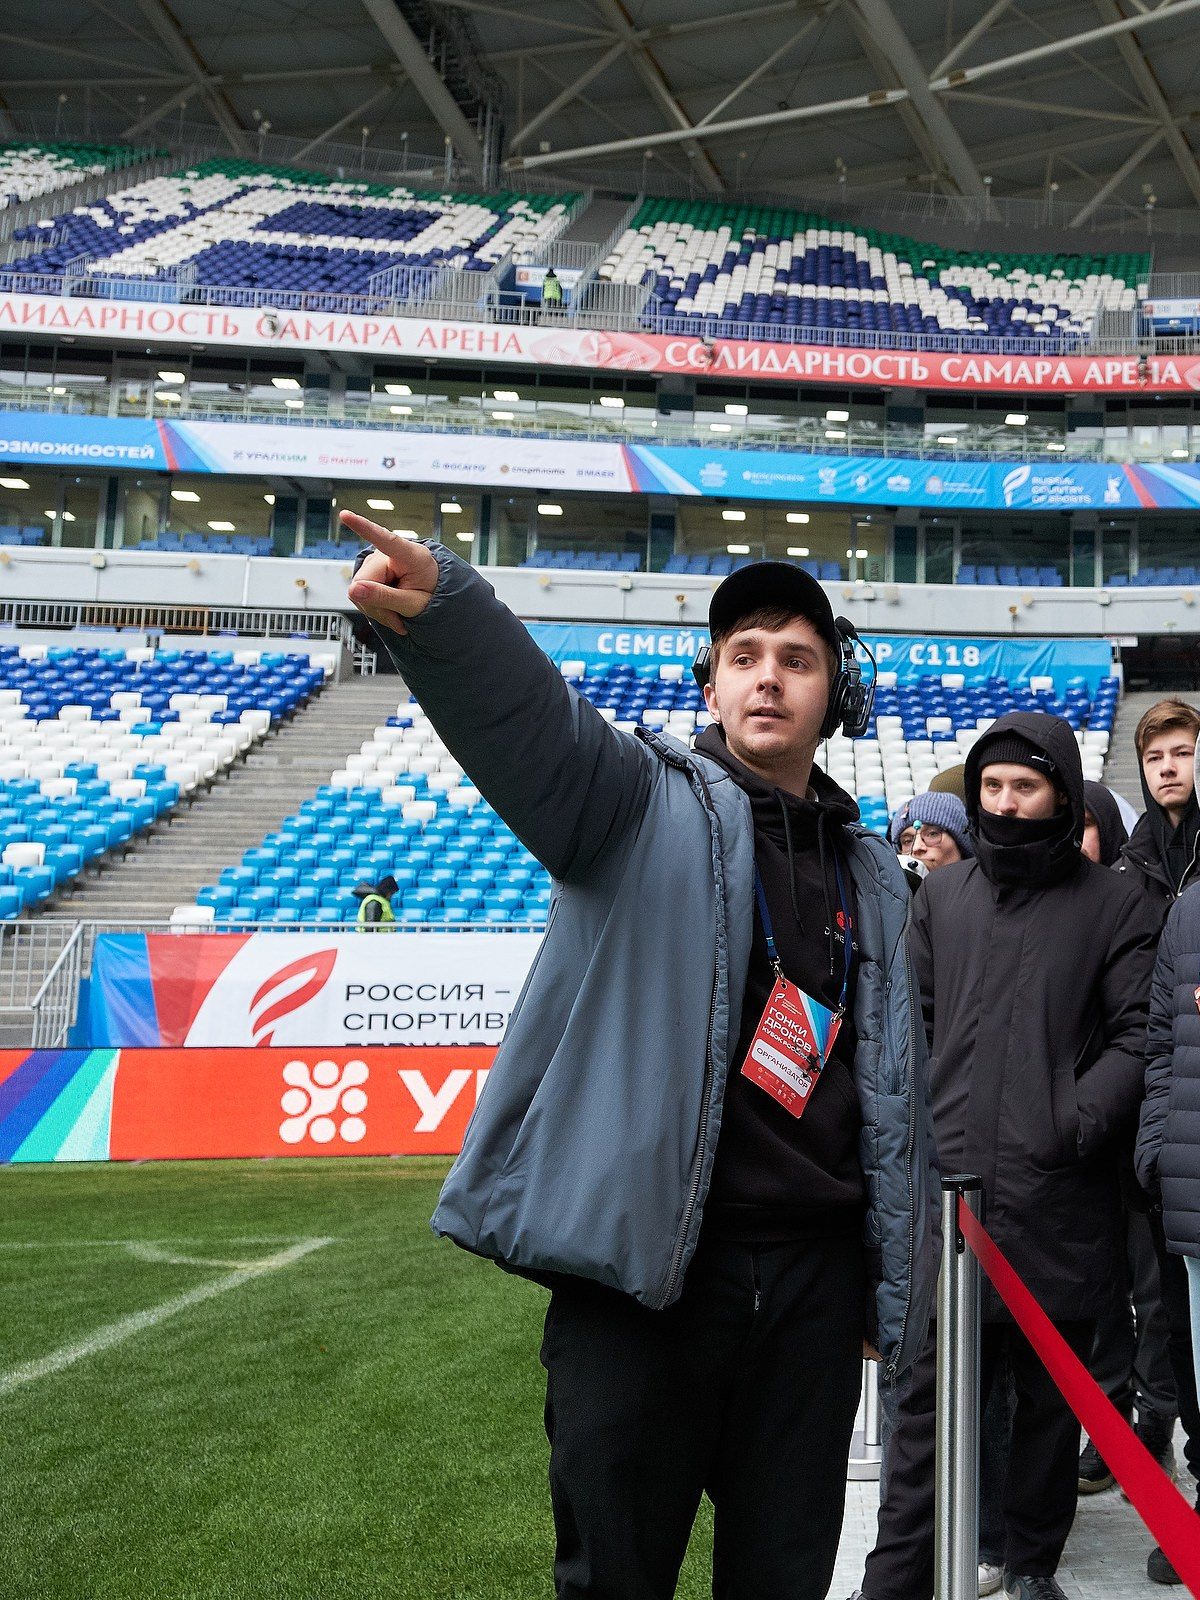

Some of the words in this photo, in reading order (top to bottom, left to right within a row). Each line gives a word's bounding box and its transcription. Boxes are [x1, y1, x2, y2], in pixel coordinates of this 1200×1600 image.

[0, 300, 240, 337] ЛИДАРНОСТЬ
[256, 312, 402, 347] САМАРА
[417, 326, 523, 354] АРЕНА
[664, 341, 929, 381] СОЛИДАРНОСТЬ
[940, 358, 1073, 385] САМАРА
[246, 451, 308, 463] УРАЛХИМ
[345, 983, 484, 1001] РОССИЯ
[343, 1012, 512, 1031] СПОРТИВ
[762, 1026, 783, 1043] КУБОК
[764, 1016, 812, 1053] ДРОНОВ
[768, 1006, 808, 1038] ГОНКИ
[756, 1047, 809, 1088] ОРГАНИЗАТОР
